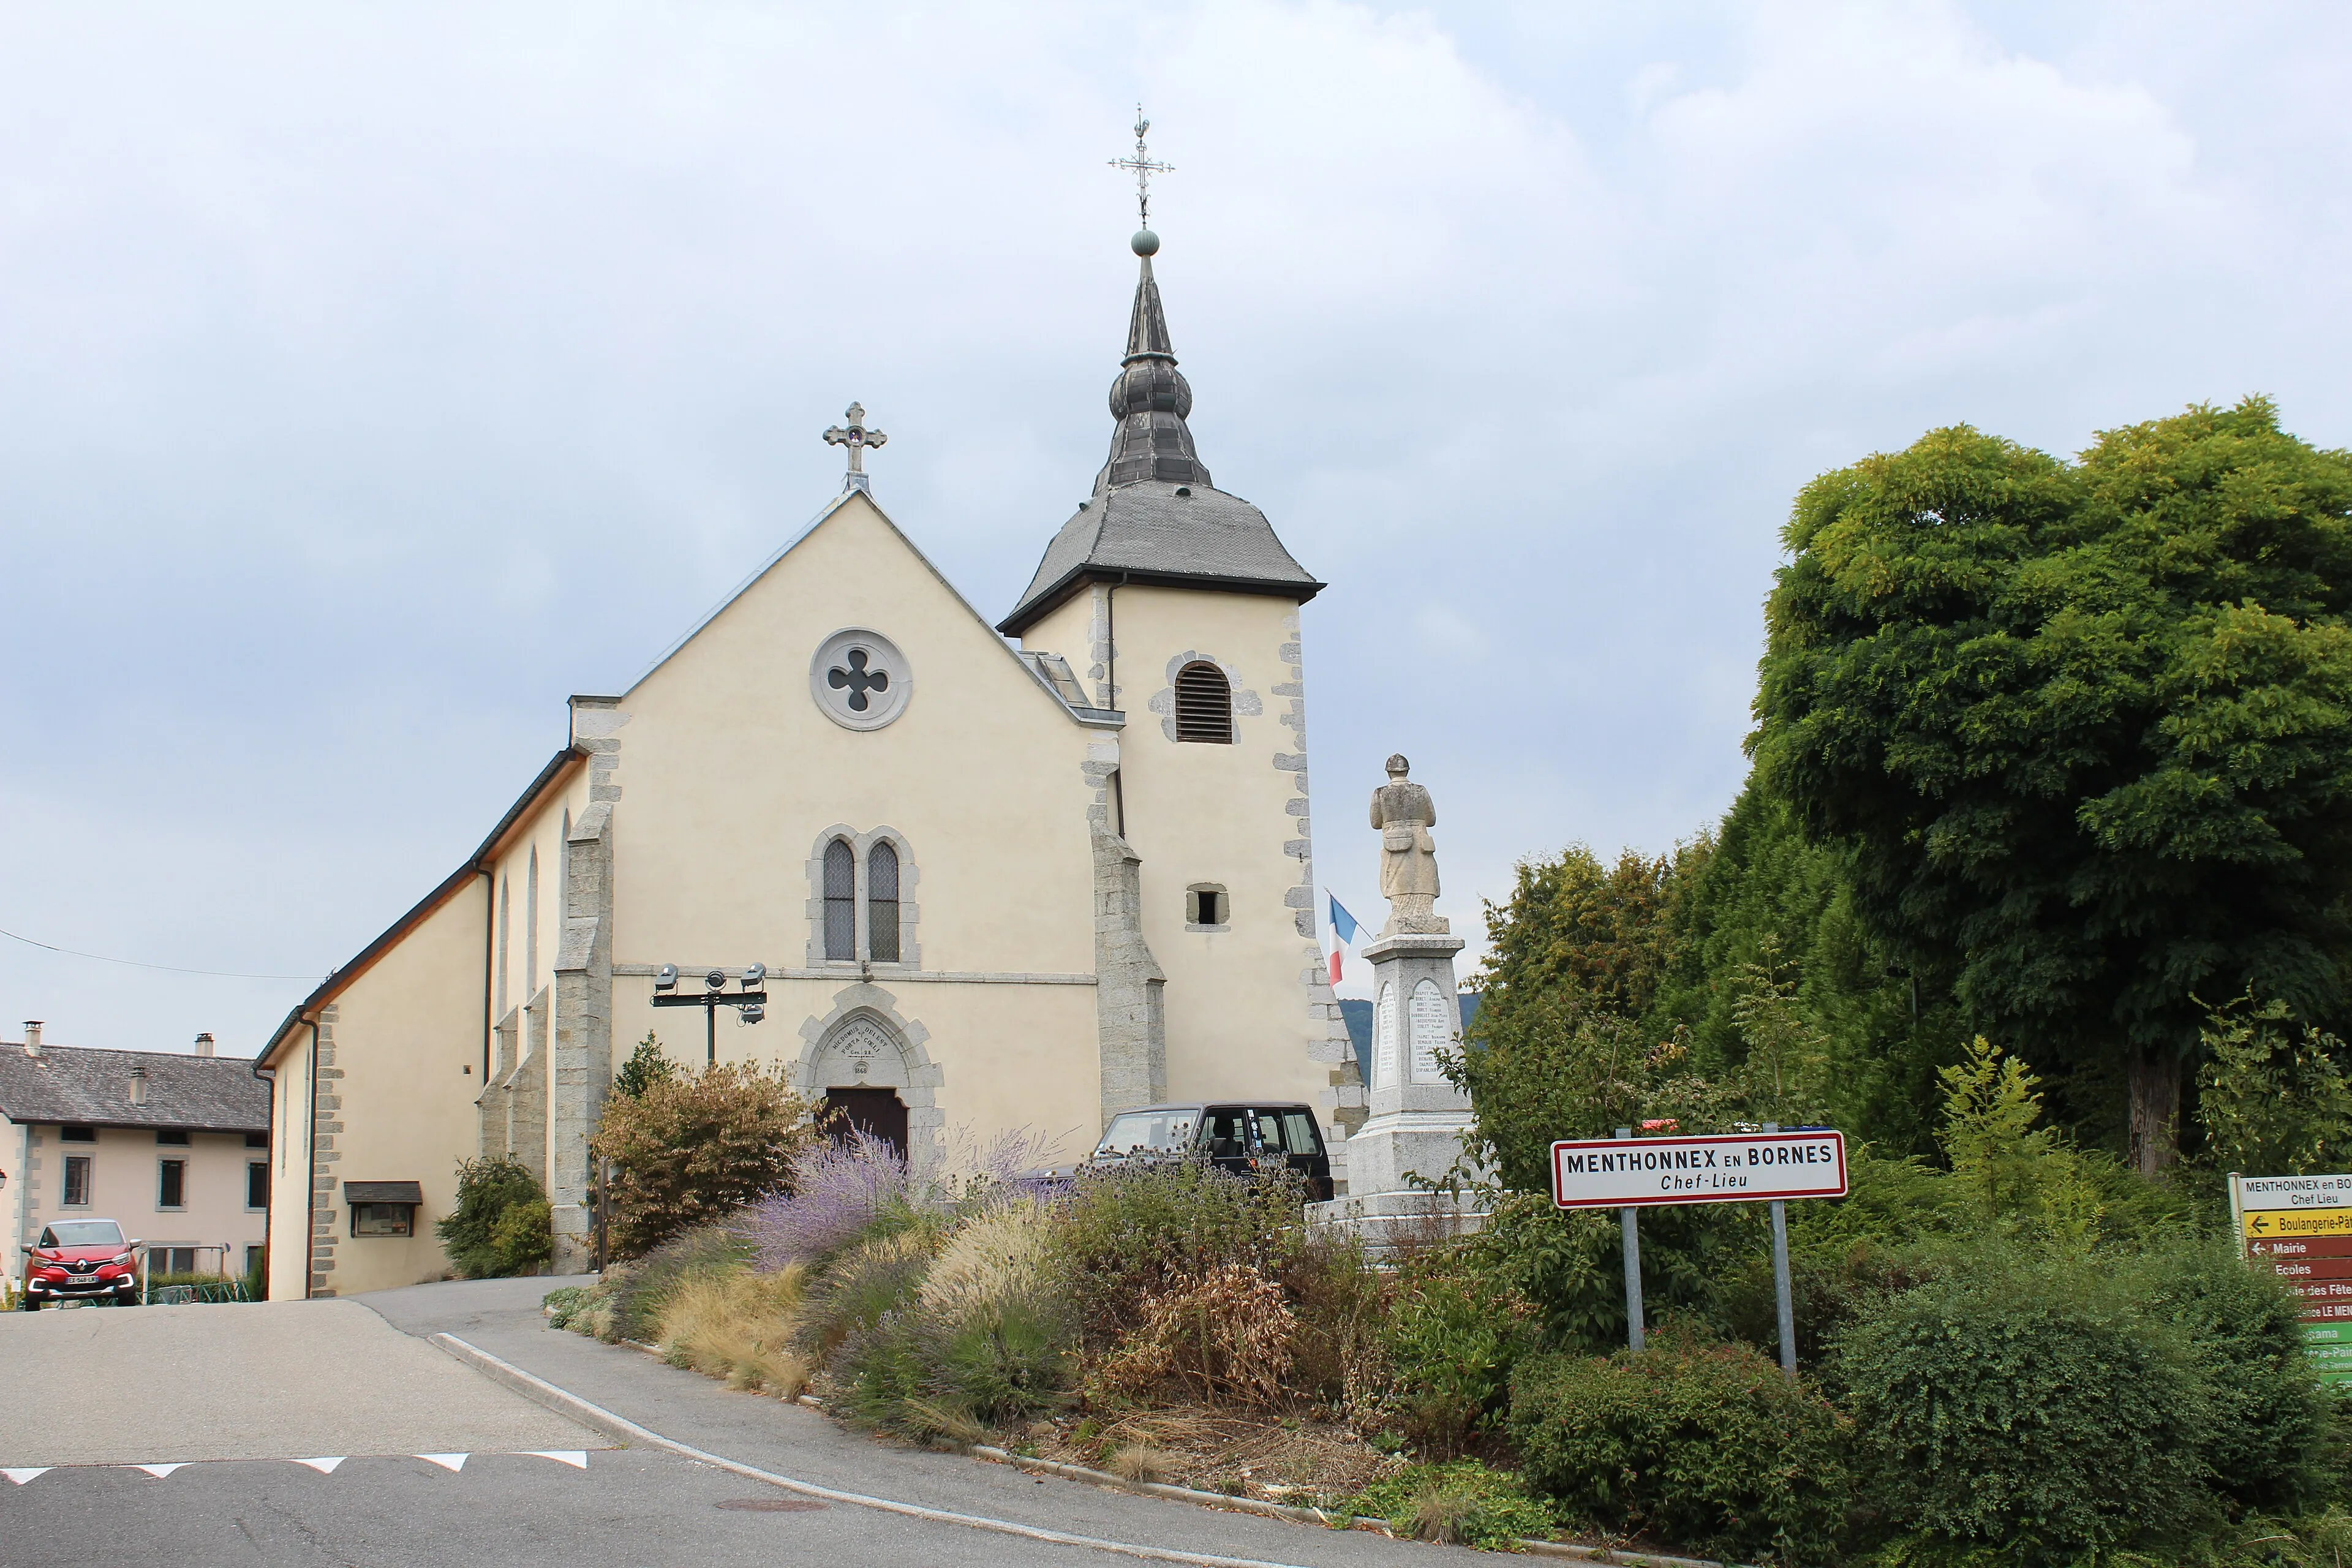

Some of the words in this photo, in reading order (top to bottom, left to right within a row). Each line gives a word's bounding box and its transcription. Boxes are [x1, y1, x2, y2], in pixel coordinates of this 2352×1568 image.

[841, 1038, 860, 1054] PORTA
[1567, 1149, 1716, 1174] MENTHONNEX
[1724, 1155, 1741, 1167] EN
[1747, 1145, 1832, 1166] BORNES
[1660, 1172, 1747, 1191] Chef-Lieu
[2245, 1180, 2320, 1193] MENTHONNEX
[2337, 1178, 2352, 1189] BO
[2291, 1194, 2314, 1205] Chef
[2317, 1193, 2338, 1204] Lieu
[2273, 1242, 2307, 1254] Mairie
[2275, 1264, 2311, 1275] Ecoles
[2307, 1285, 2327, 1296] des
[2322, 1305, 2333, 1317] LE
